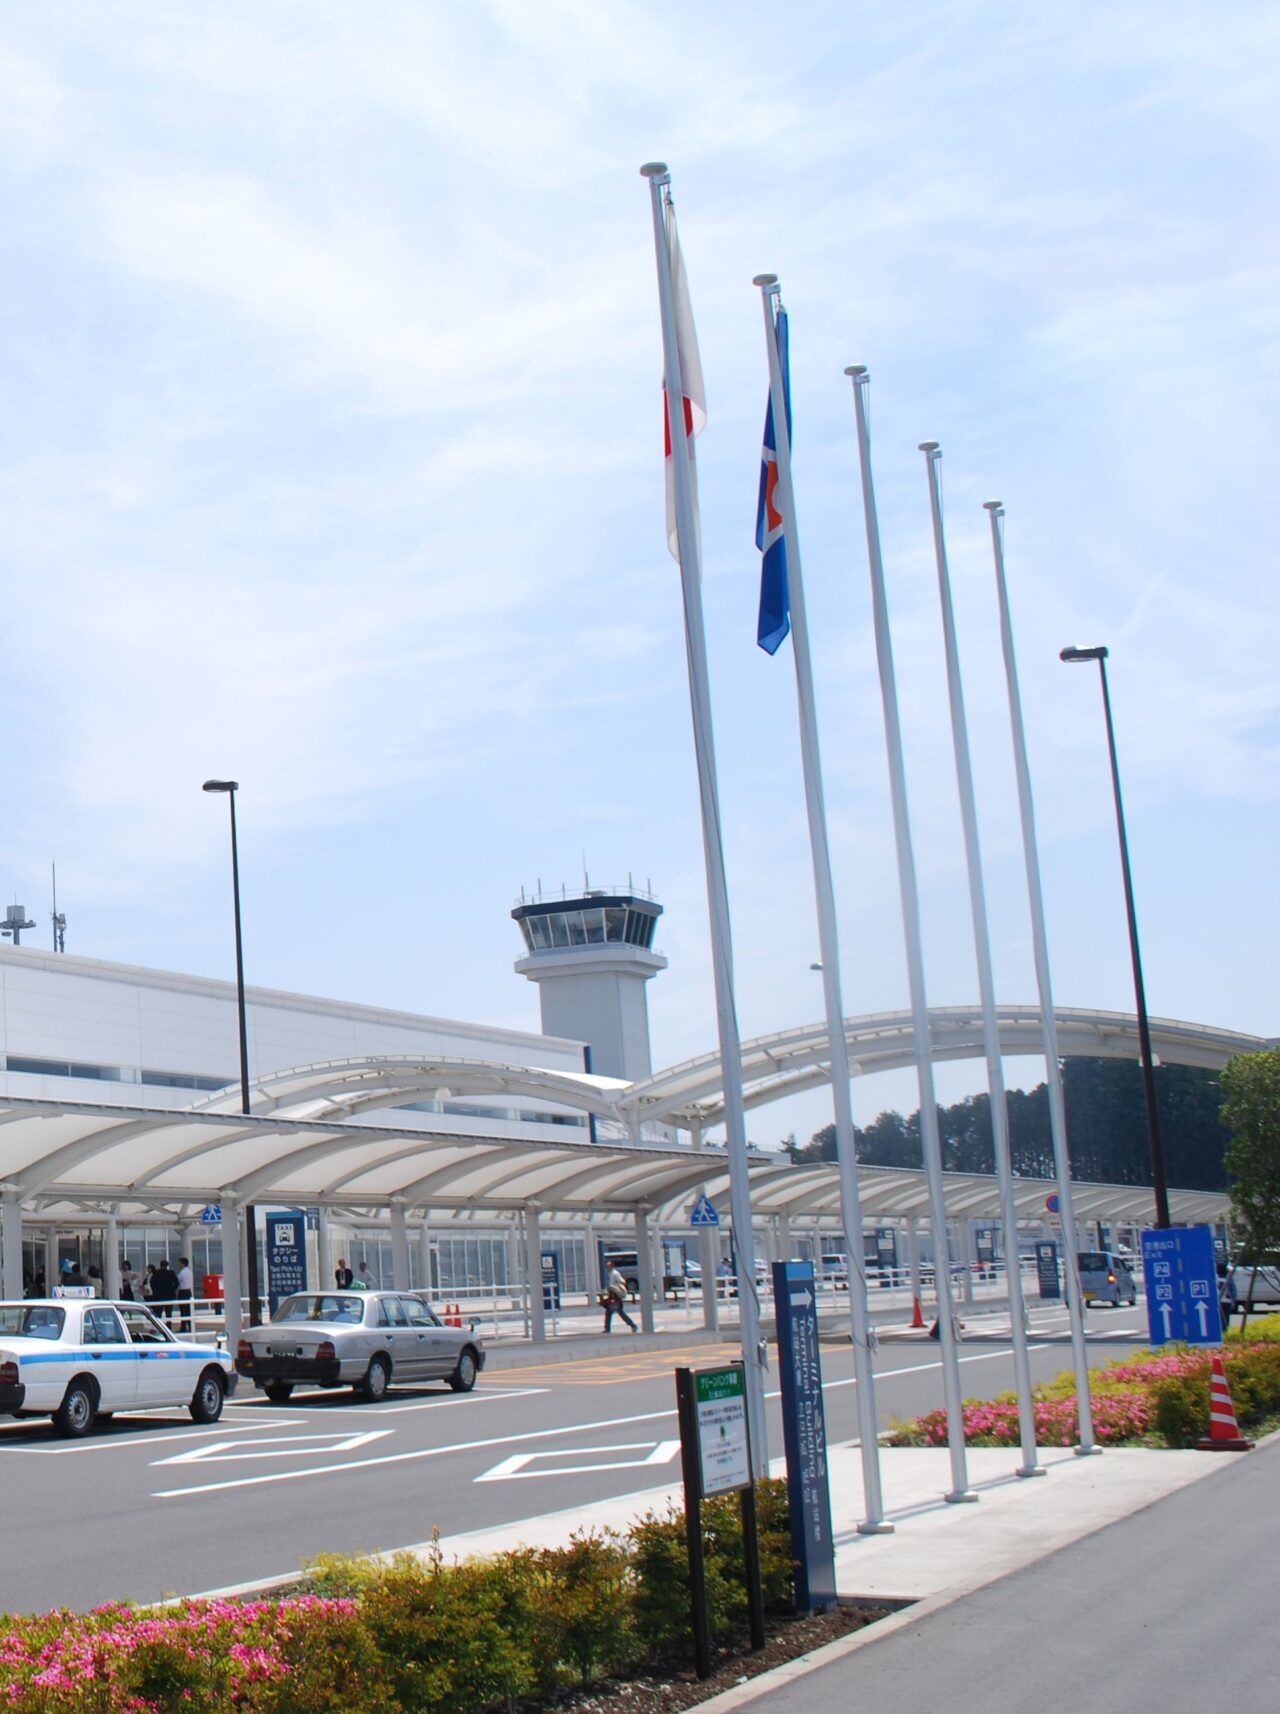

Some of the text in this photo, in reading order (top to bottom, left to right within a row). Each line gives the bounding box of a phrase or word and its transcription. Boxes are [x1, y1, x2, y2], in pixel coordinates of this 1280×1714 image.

[1144, 1240, 1174, 1250] 空港出口
[1144, 1251, 1163, 1259] Exit
[1155, 1265, 1167, 1275] P4
[1159, 1288, 1170, 1298] P2
[1193, 1284, 1206, 1295] P1
[800, 1314, 816, 1478] Terminal Building
[807, 1315, 825, 1477] ターミナルビル
